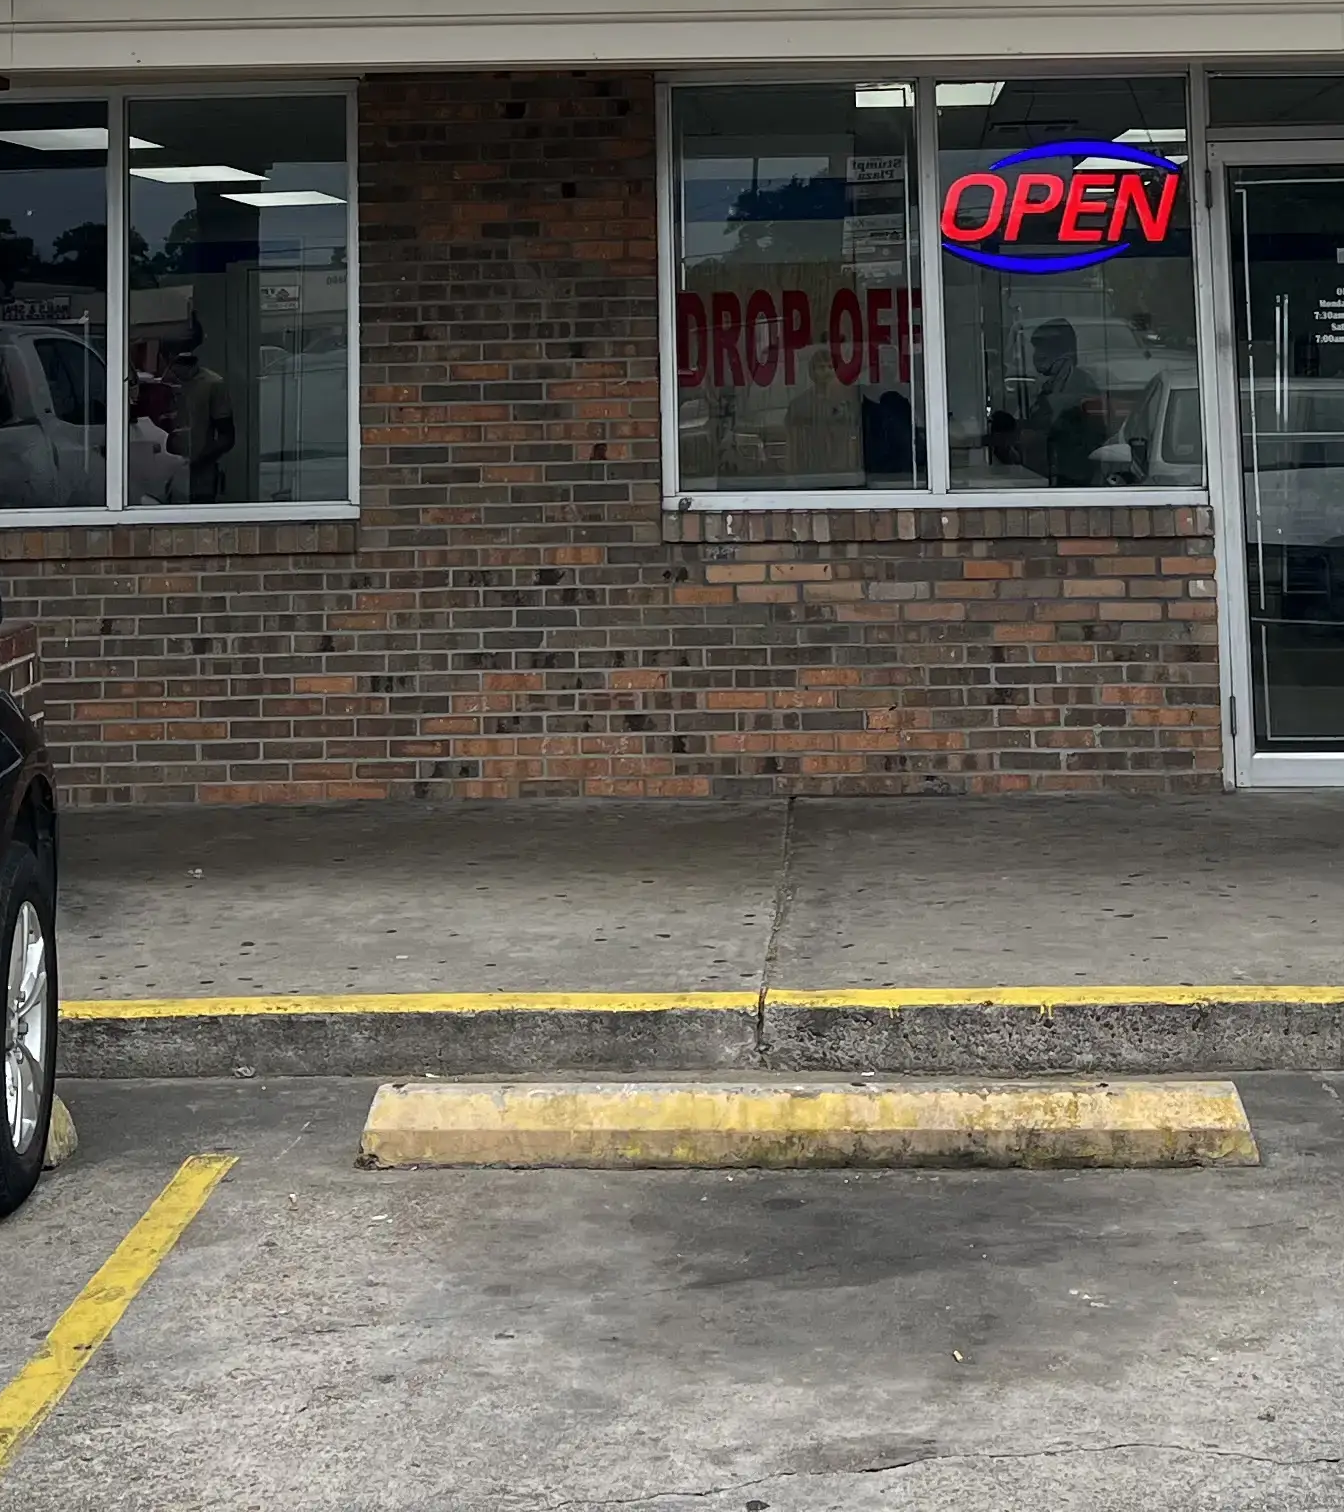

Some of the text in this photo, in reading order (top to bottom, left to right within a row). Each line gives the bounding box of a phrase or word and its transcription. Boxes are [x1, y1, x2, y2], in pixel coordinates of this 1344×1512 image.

[940, 173, 1181, 243] OPEN
[676, 287, 922, 389] DROP OFF
